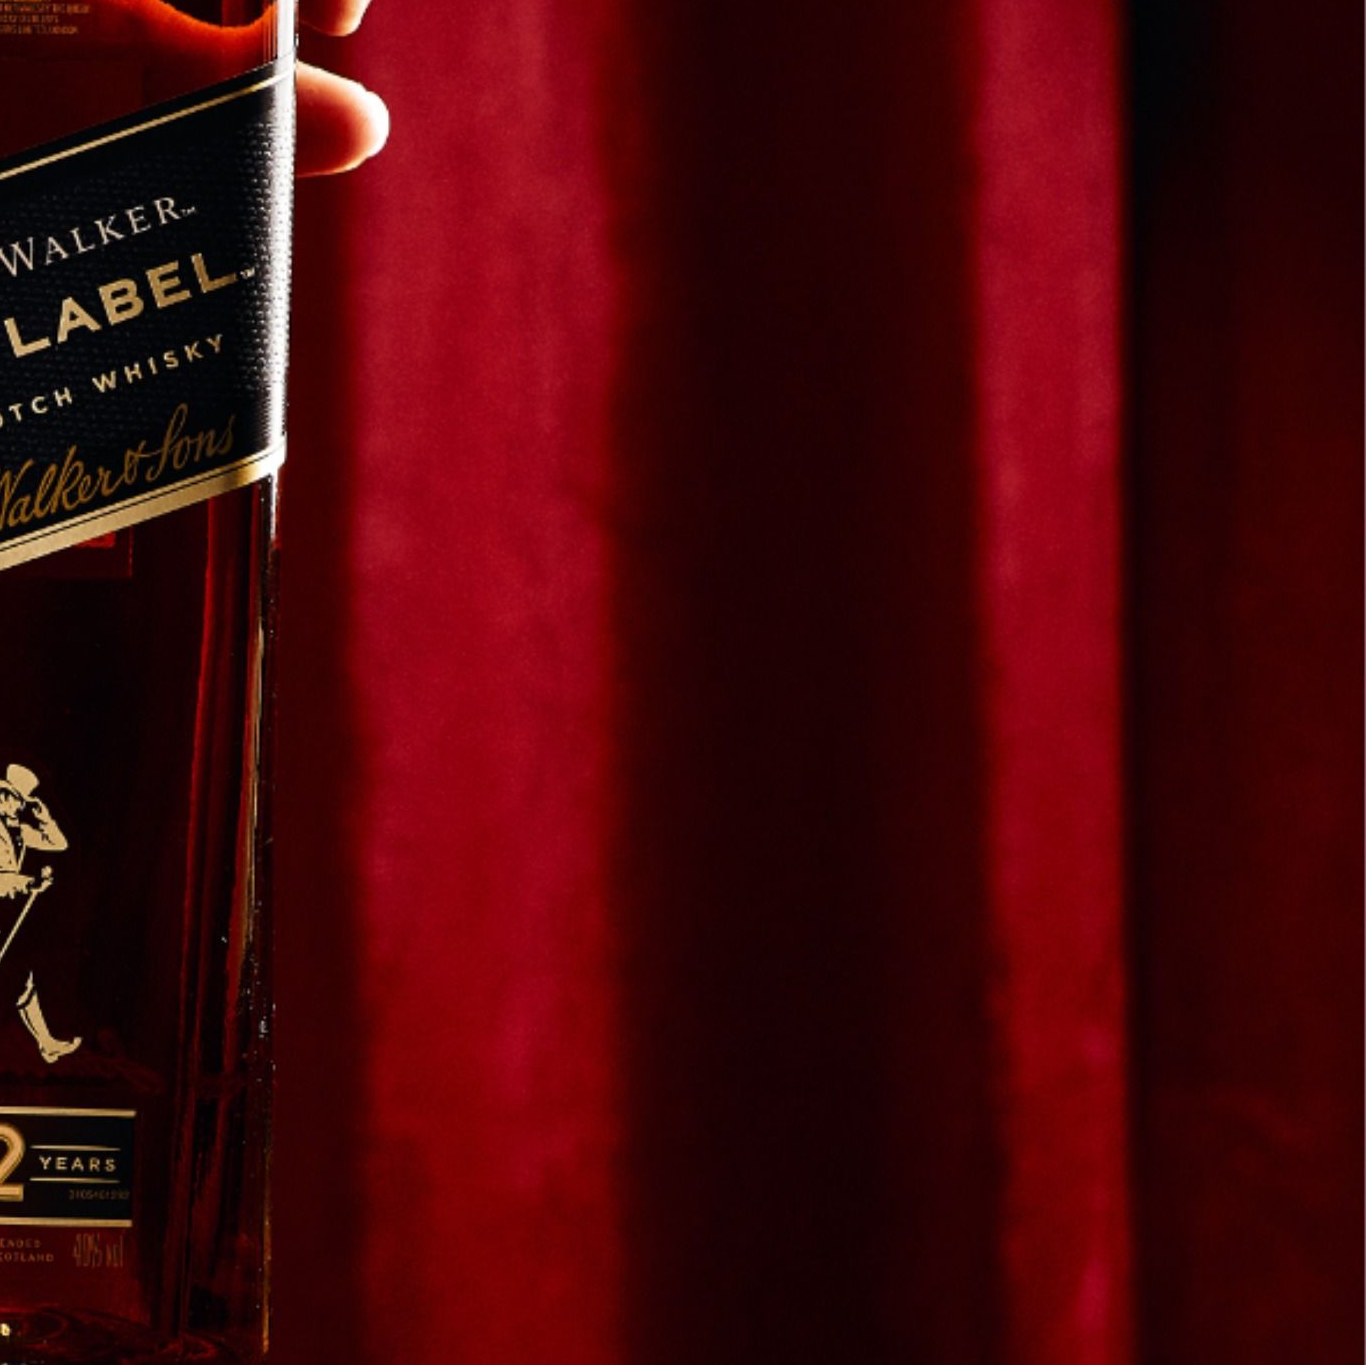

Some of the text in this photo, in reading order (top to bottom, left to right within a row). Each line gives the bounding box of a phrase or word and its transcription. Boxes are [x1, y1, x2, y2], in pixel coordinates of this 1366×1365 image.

[92, 333, 225, 393] WHISKY
[146, 402, 235, 483] Sons
[39, 1155, 117, 1172] YEARS
